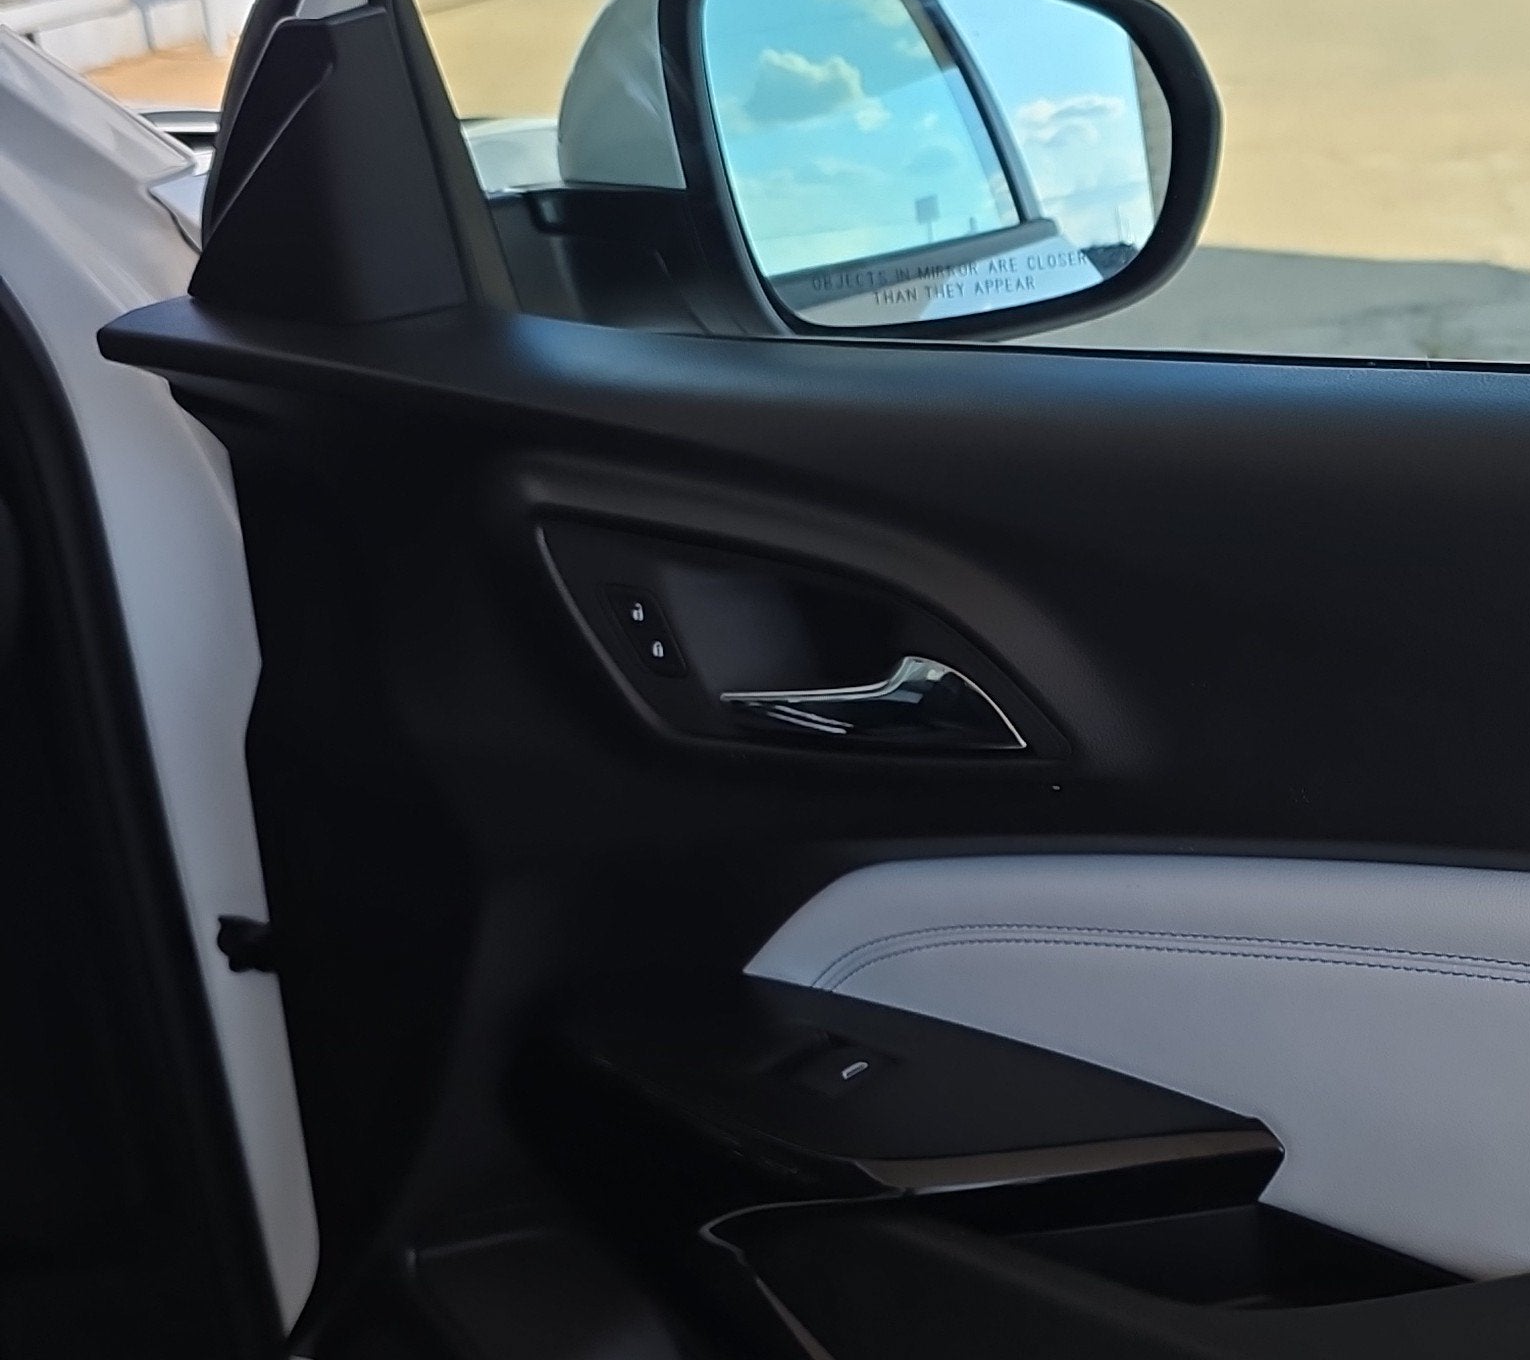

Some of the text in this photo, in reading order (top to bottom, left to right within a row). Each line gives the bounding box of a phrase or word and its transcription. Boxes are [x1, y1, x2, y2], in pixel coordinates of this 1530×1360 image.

[896, 266, 910, 281] IN
[988, 257, 1017, 275] ARE
[1027, 249, 1088, 271] CLOSER
[873, 274, 1036, 306] THAN THEY APPEAR
